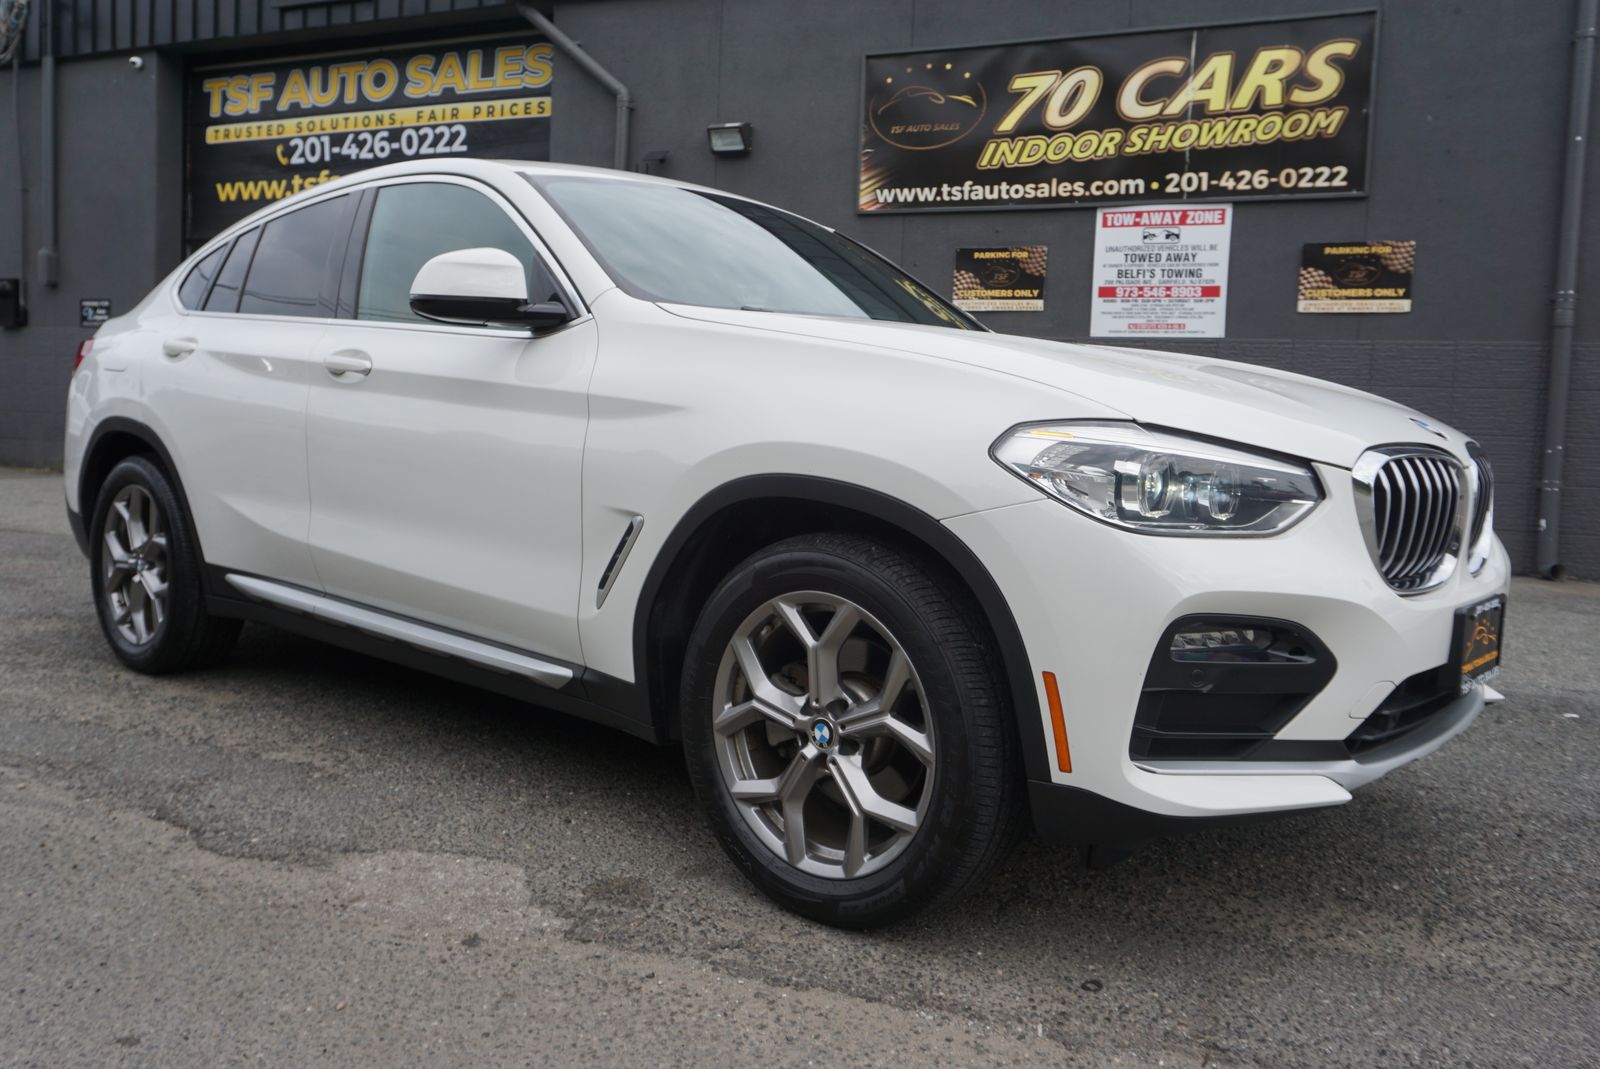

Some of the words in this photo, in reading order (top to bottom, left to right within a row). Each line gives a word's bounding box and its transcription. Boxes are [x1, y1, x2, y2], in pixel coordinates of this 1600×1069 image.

[203, 72, 276, 117] TSF
[276, 58, 399, 111] AUTO
[403, 43, 553, 98] SALES
[995, 65, 1103, 135] 70
[1117, 39, 1360, 122] CARS
[213, 125, 285, 140] TRUSTED
[296, 113, 403, 133] SOLUTIONS,
[416, 107, 459, 122] FAIR
[473, 101, 546, 118] PRICES
[906, 124, 930, 133] AUTO
[289, 124, 468, 165] 201-426-0222
[977, 128, 1125, 169] INDOOR
[1124, 106, 1349, 154] SHOWROOM
[216, 169, 340, 202] www.tsf
[875, 176, 1145, 204] www.tsfautosales.com
[1164, 166, 1348, 194] 201-426-0222
[1105, 211, 1182, 226] TOW-AWAY
[1186, 210, 1223, 224] ZONE
[1124, 253, 1162, 263] TOWED
[1165, 252, 1197, 262] AWAY
[1324, 247, 1370, 255] PARKING
[1117, 268, 1156, 278] BELFI'S
[1161, 268, 1202, 278] TOWING
[1014, 289, 1039, 297] ONLY
[1305, 288, 1373, 297] CUSTOMERS
[1374, 288, 1405, 296] ONLY
